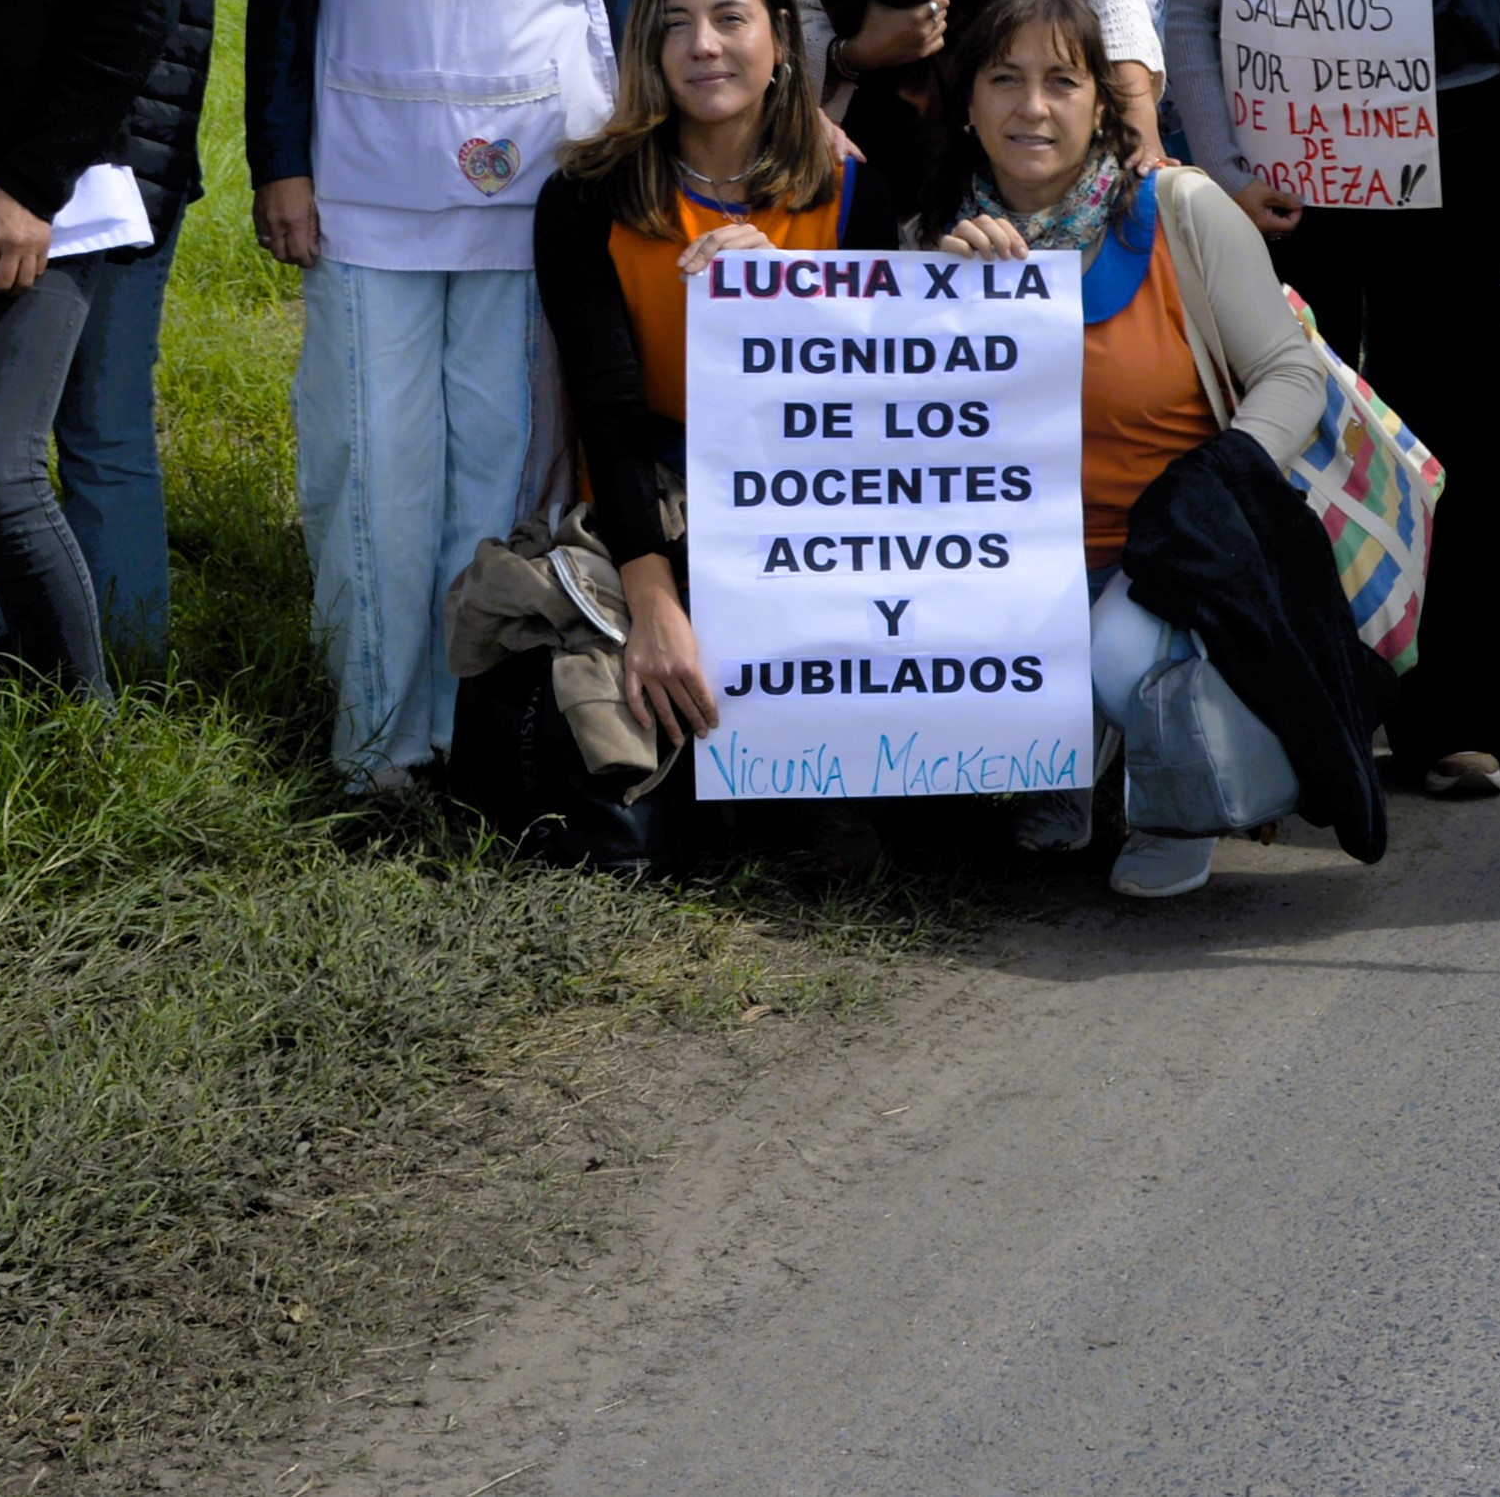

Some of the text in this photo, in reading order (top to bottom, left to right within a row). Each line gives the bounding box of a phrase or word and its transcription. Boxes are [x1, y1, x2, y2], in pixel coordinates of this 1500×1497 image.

[1236, 44, 1431, 93] POR DEBAJO
[1234, 91, 1436, 138] DE LA LÍNEA
[1302, 136, 1338, 161] DE
[709, 259, 1051, 301] LUCHA X LA
[741, 335, 1019, 375] DIGNIDAD
[783, 401, 991, 439] DE LOS
[733, 465, 1033, 508] DOCENTES
[763, 534, 1011, 573] ACTIVOS
[873, 599, 911, 637] Y
[723, 655, 1044, 697] JUBILADOS
